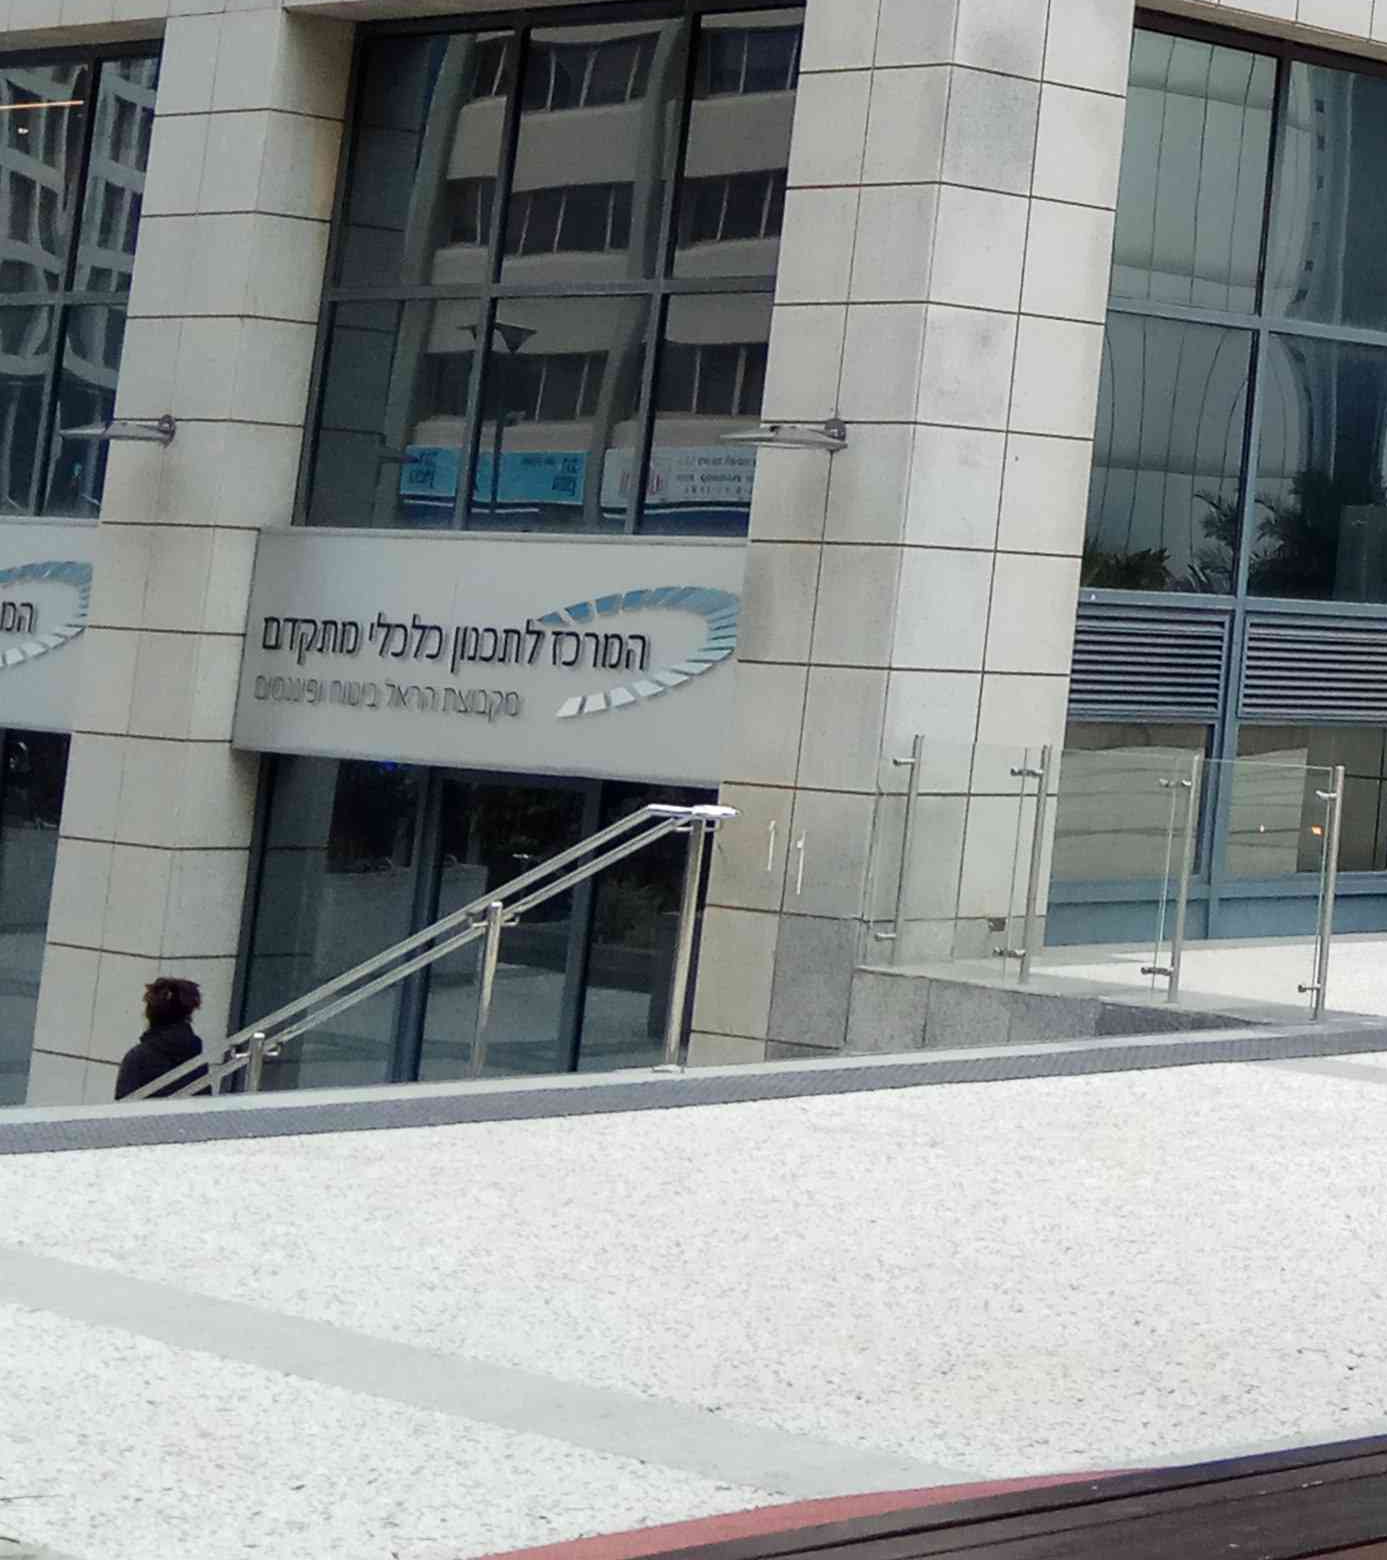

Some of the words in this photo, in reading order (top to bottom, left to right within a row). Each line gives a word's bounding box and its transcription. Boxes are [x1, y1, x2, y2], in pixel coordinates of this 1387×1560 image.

[261, 615, 360, 665] מתקדם
[368, 611, 445, 660] כלכלי
[450, 618, 544, 674] לתכנון
[551, 629, 650, 671] המרכז
[327, 679, 378, 709] ביטוח
[384, 682, 437, 713] הראל
